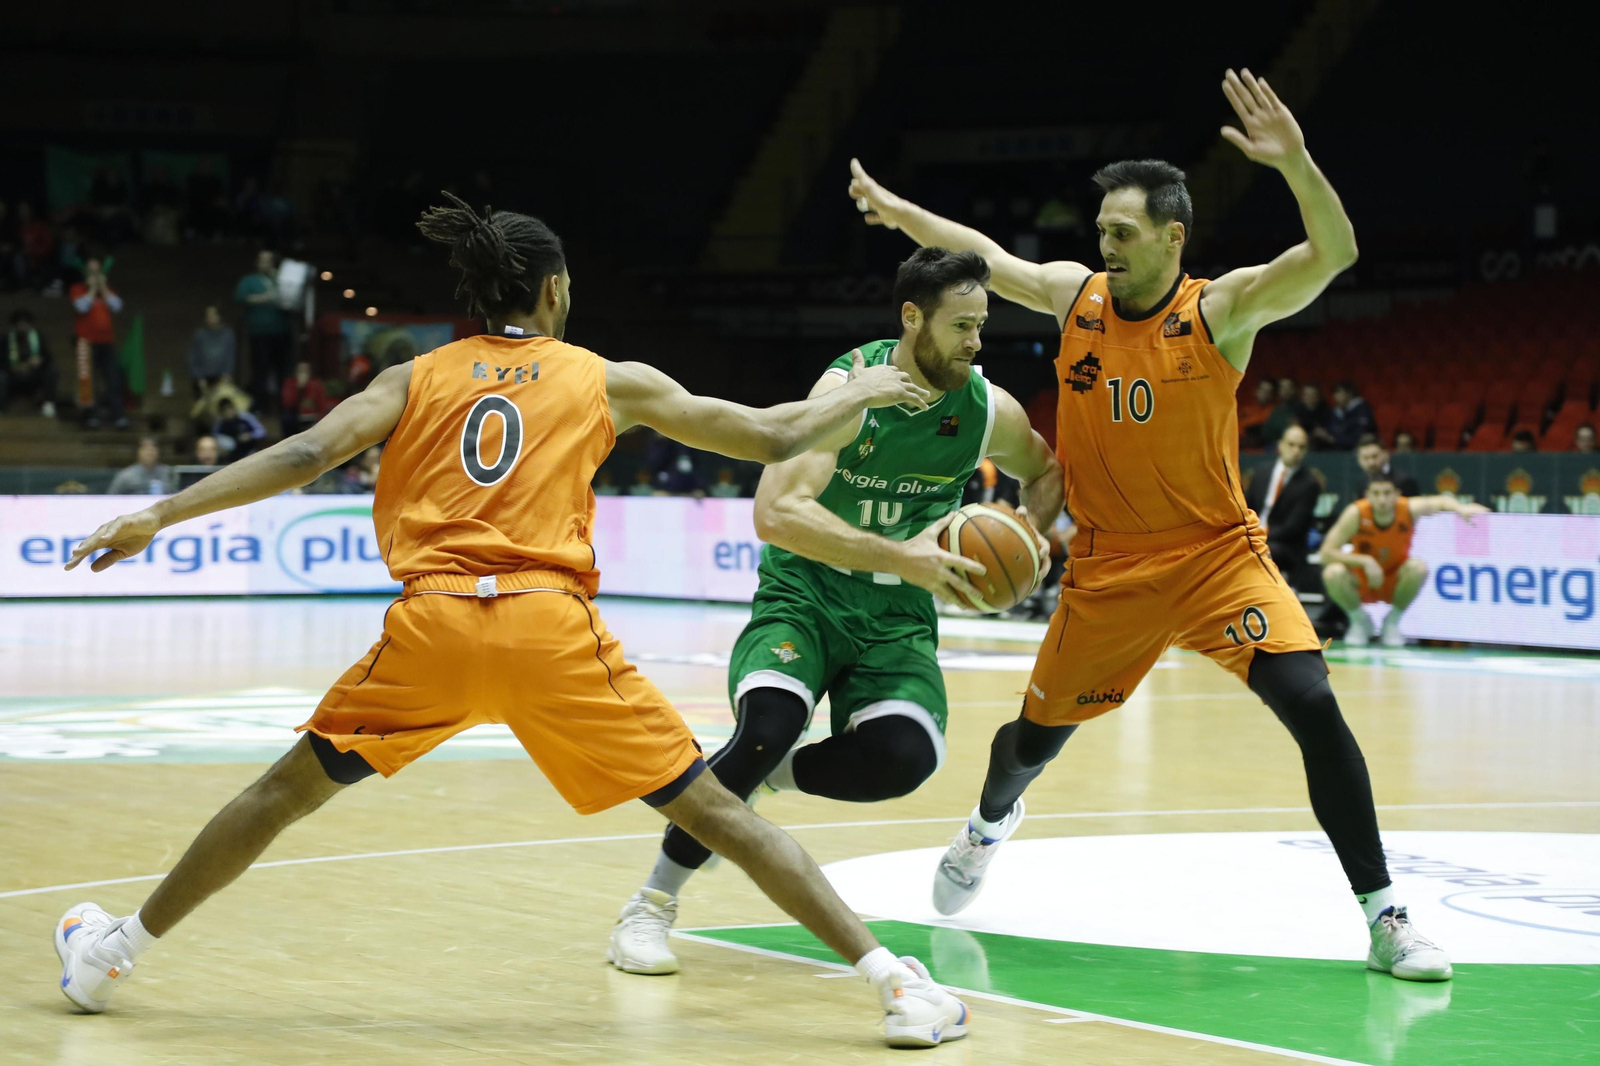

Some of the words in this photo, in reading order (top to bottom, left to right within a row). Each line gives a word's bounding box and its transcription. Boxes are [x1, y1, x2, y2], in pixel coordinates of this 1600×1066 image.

[471, 361, 540, 384] KYEI
[1106, 376, 1154, 424] 10
[460, 393, 524, 487] 0
[857, 499, 903, 527] 10
[302, 526, 387, 571] plu
[1223, 605, 1269, 646] 10
